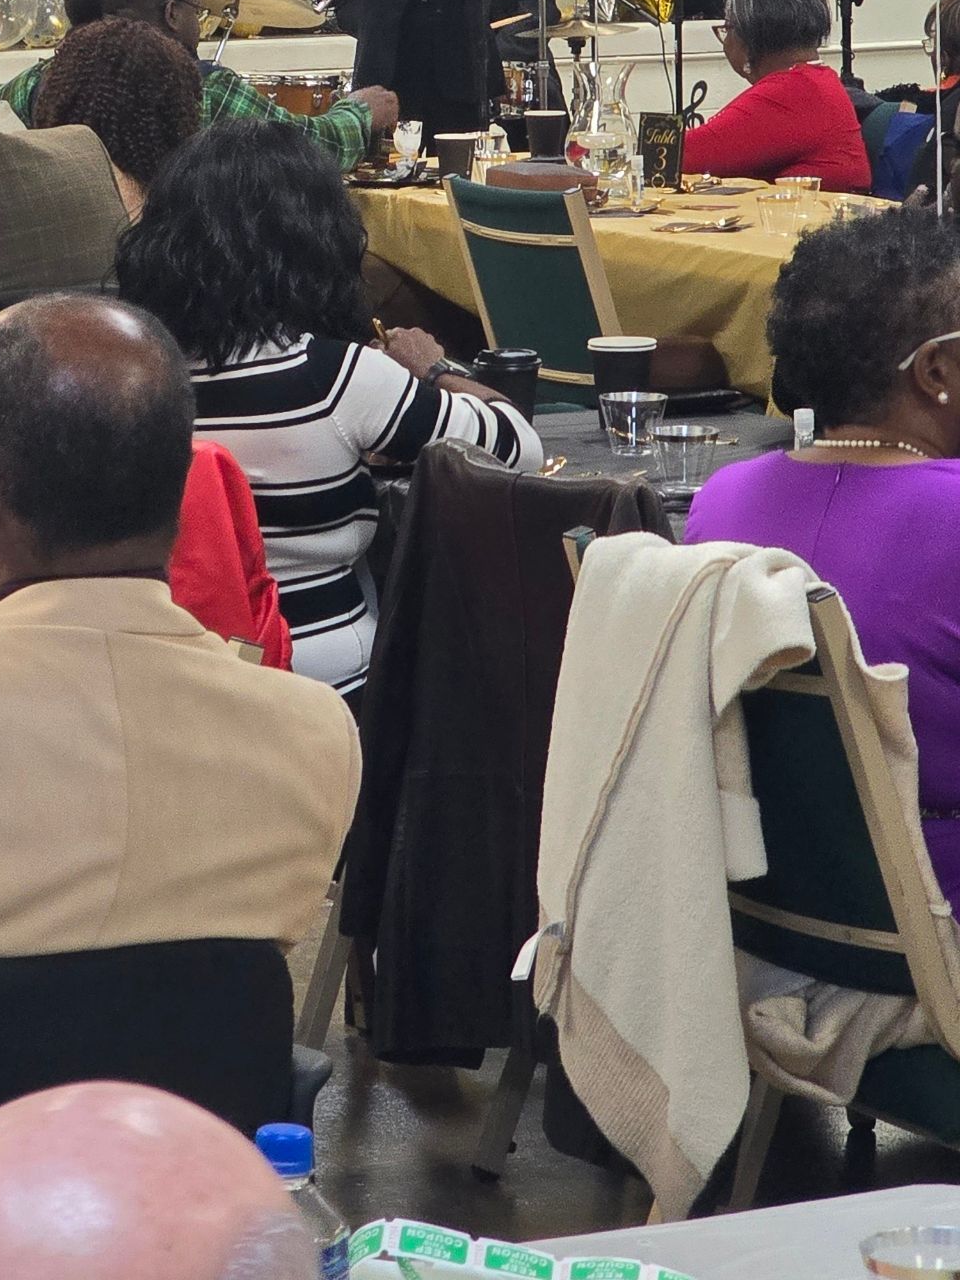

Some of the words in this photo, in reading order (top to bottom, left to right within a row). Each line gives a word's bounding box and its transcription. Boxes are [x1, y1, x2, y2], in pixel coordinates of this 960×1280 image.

[645, 127, 677, 145] Table
[653, 146, 667, 170] 3
[406, 1228, 463, 1248] COUPON
[415, 1245, 451, 1259] KEEP
[491, 1247, 548, 1267] COUPON
[501, 1263, 537, 1277] KEEP
[576, 1261, 635, 1270] COUPON
